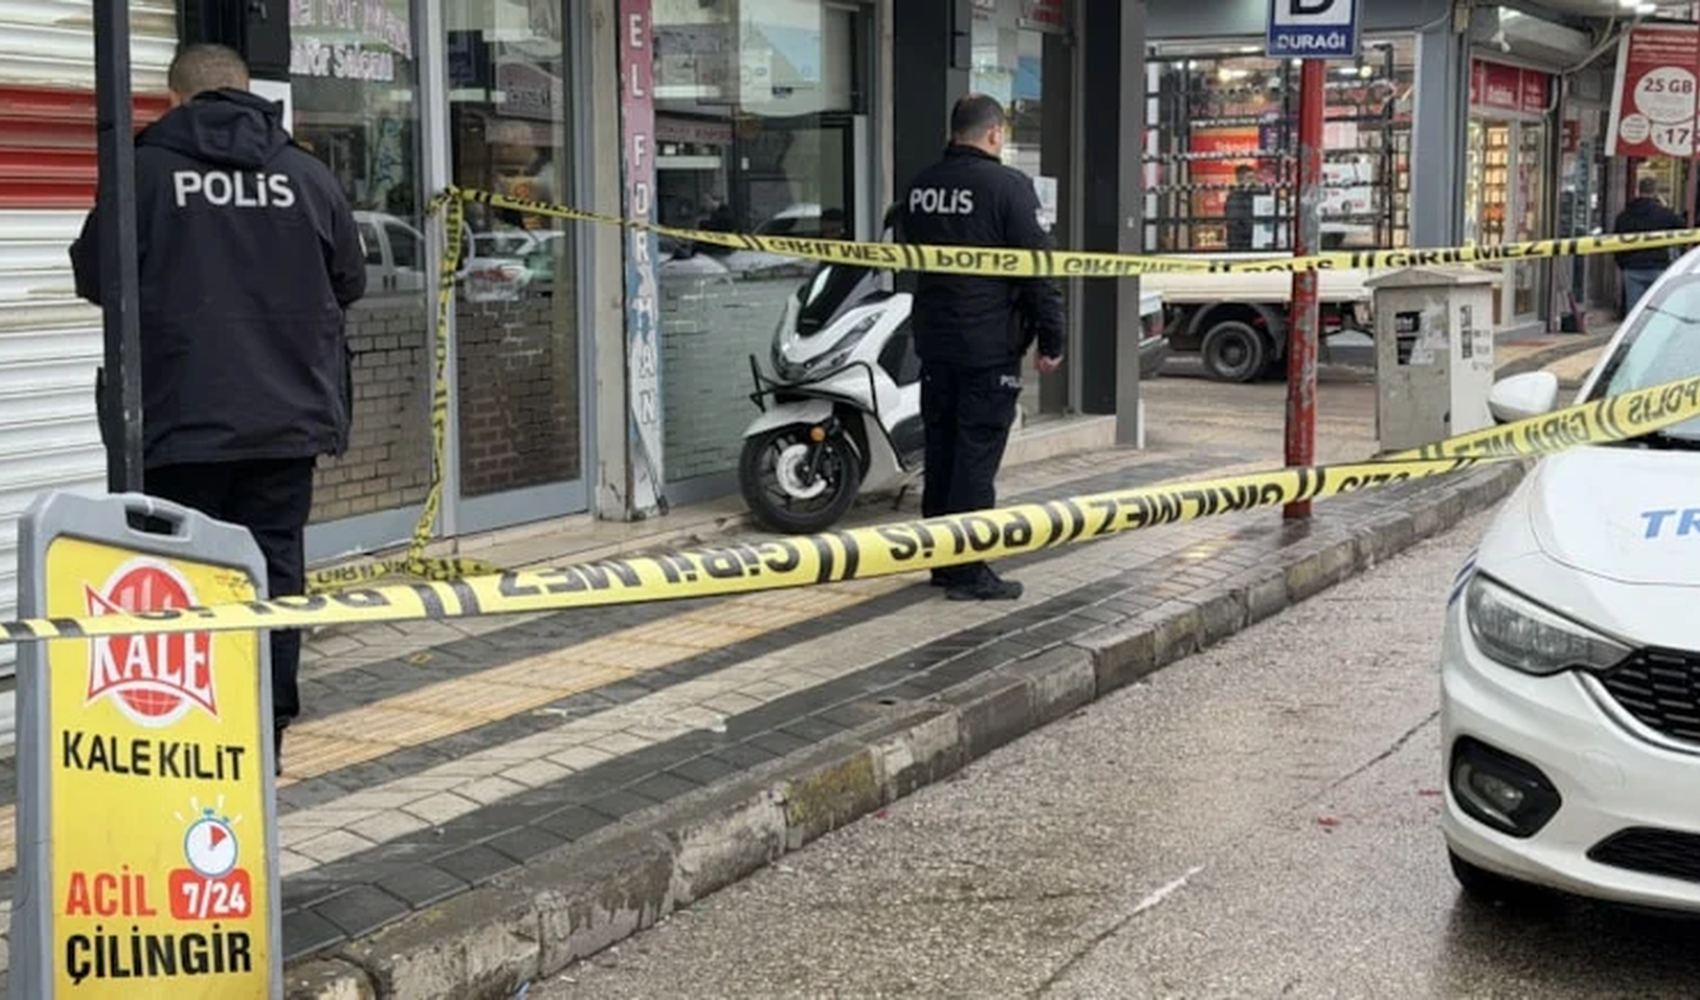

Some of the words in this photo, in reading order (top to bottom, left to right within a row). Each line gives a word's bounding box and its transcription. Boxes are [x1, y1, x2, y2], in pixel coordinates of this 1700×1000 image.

[1277, 32, 1346, 49] DURAĞI
[1644, 78, 1665, 92] 25
[1668, 79, 1693, 93] GB
[63, 729, 152, 777] KALE
[66, 864, 157, 917] ACİL
[182, 878, 247, 919] 7/24
[66, 922, 252, 986] ÇİLİNGİR
